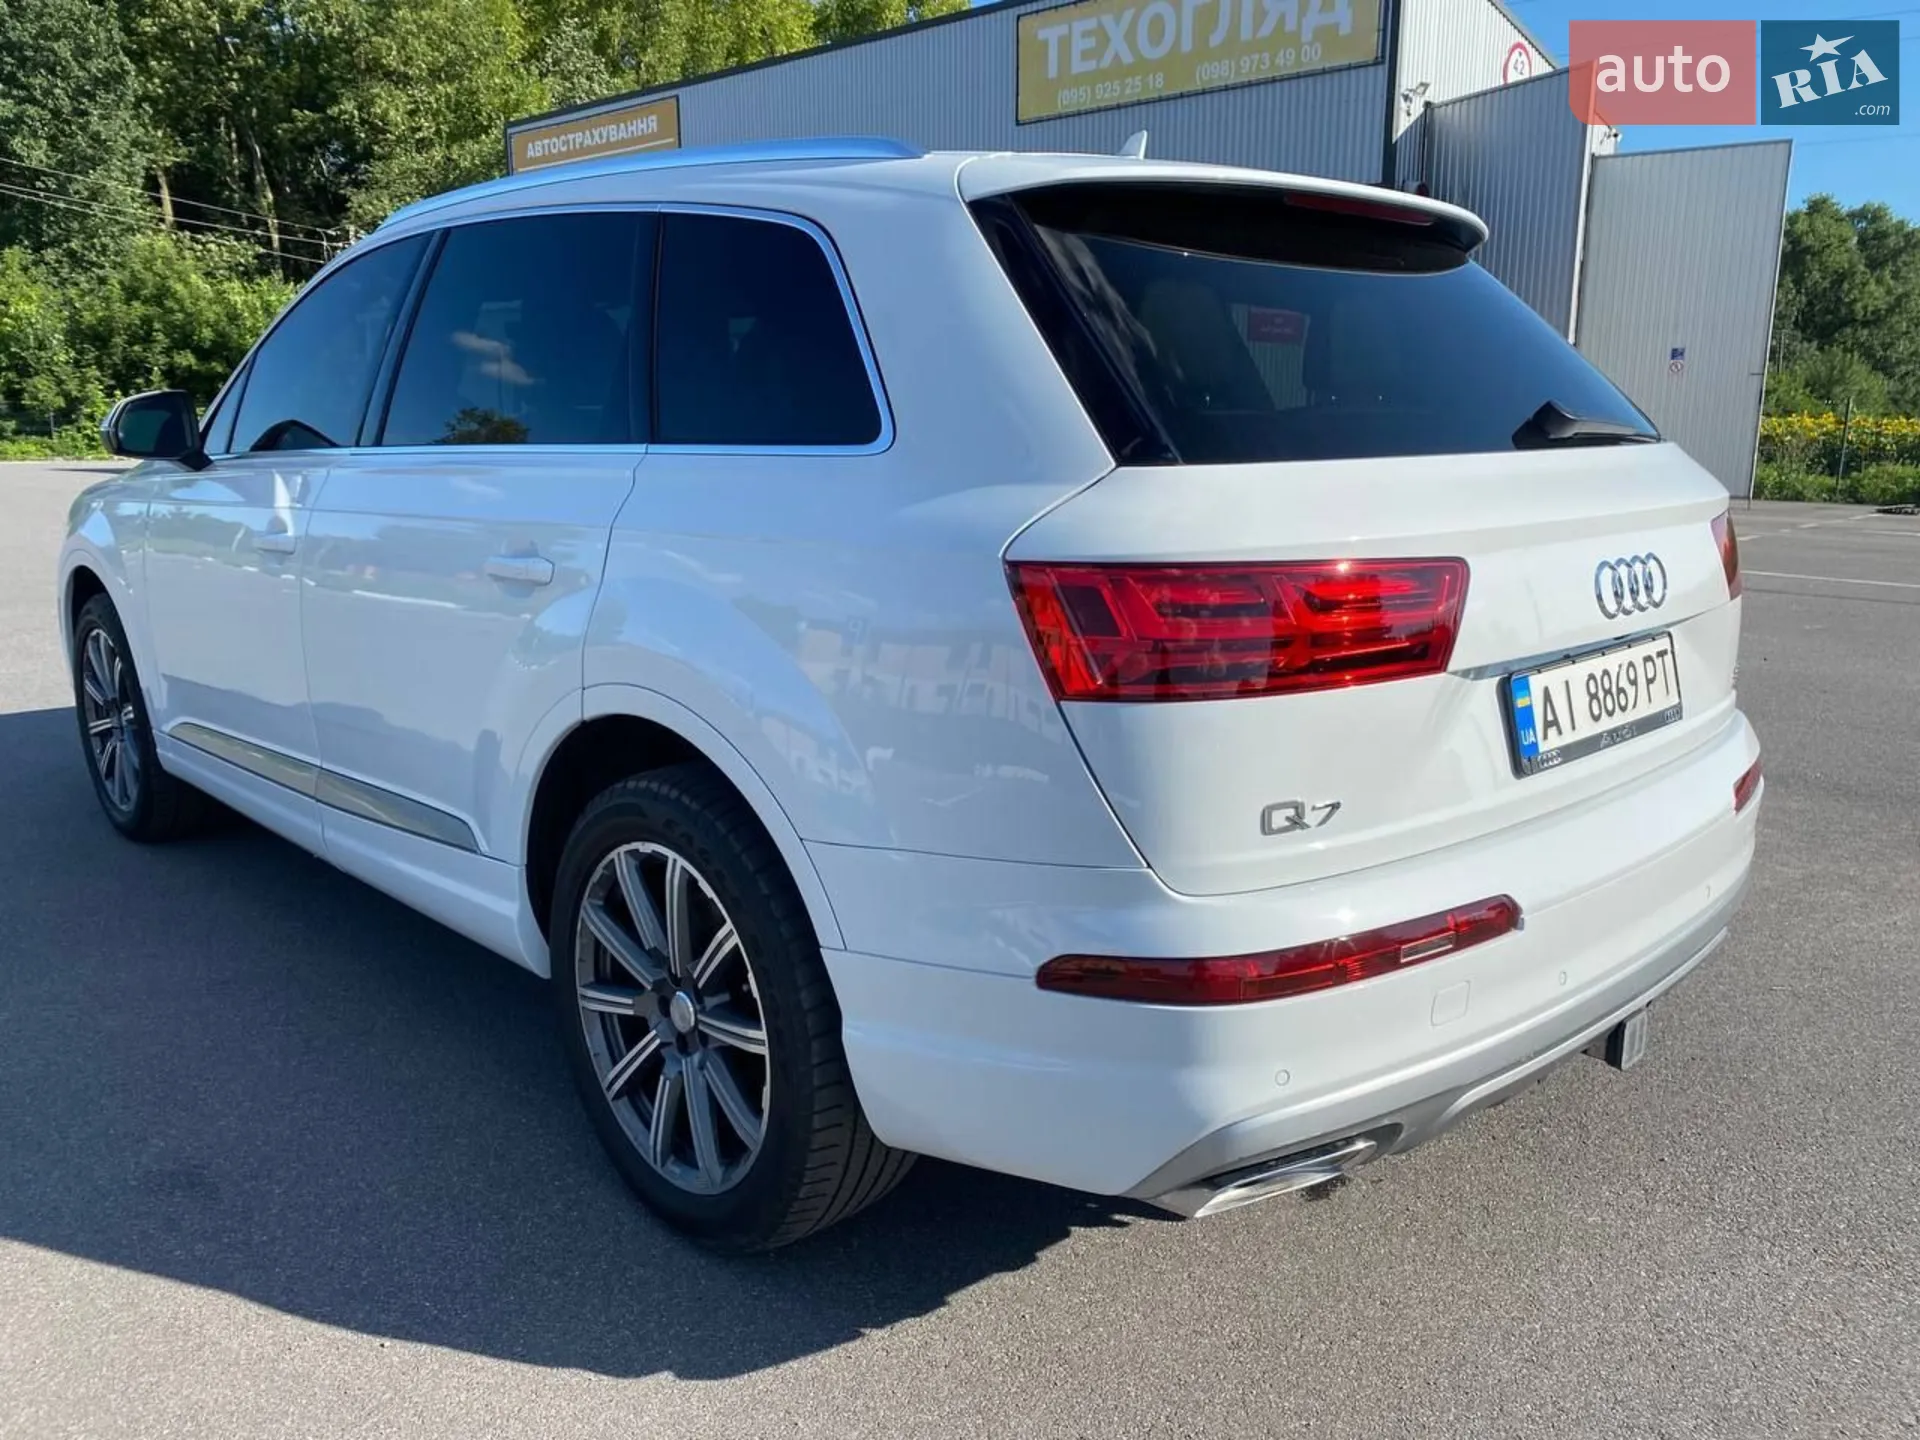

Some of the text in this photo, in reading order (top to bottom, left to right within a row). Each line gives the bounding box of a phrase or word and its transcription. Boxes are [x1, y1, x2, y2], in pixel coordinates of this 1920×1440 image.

[1037, 0, 1354, 80] ТЕХОГЛЯД
[1195, 43, 1322, 85] (098) 973 49 00
[1057, 72, 1165, 108] (095) 925 25 18
[526, 115, 658, 159] АВТОСТРАХУВАННЯ
[1542, 648, 1670, 741] AI 8869 PT
[1520, 727, 1537, 745] UA
[1260, 800, 1342, 836] Q7
